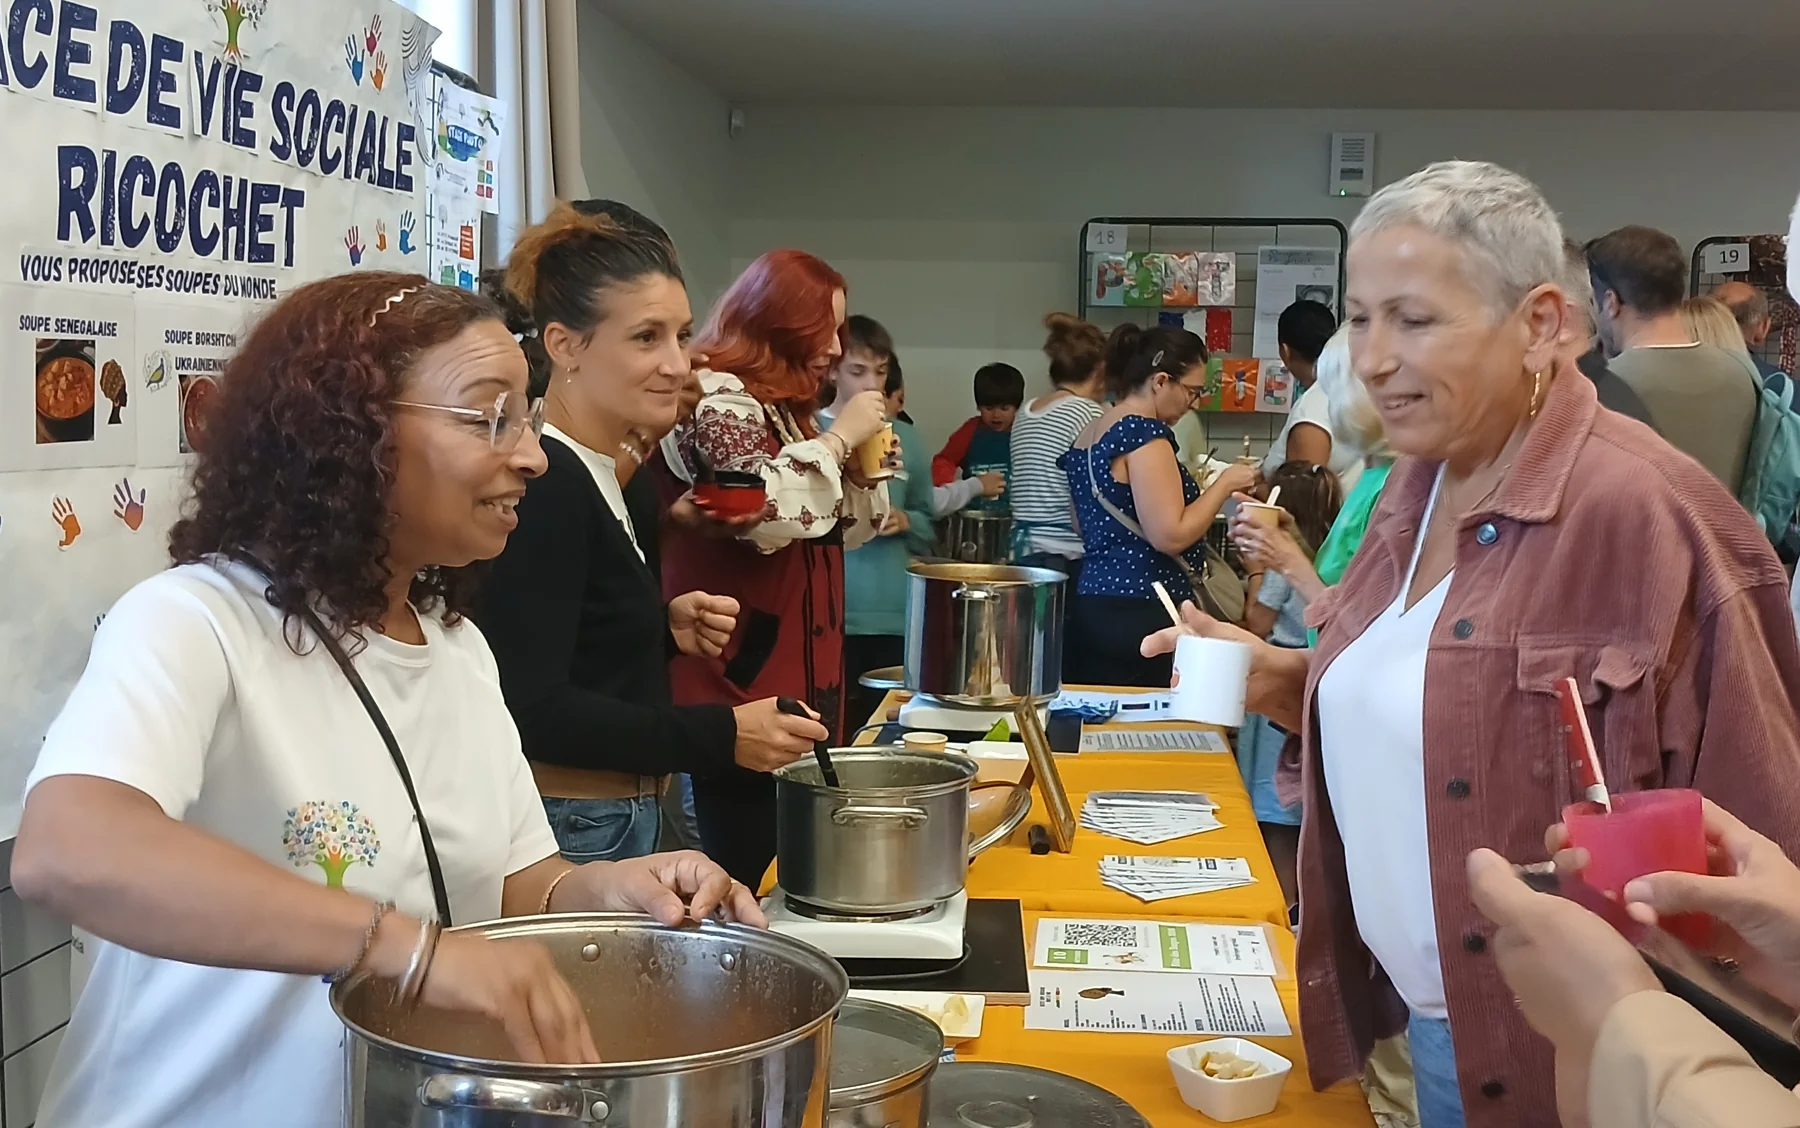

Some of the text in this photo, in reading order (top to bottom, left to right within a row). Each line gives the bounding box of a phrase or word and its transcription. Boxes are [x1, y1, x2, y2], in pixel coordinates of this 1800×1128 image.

[106, 20, 183, 128] DE
[194, 50, 263, 149] VIE
[269, 81, 415, 192] SOCIALE
[57, 145, 304, 267] RICOCHET
[1095, 230, 1115, 245] 18
[1719, 249, 1739, 264] 19
[21, 254, 278, 300] VOUS PROPOSE SES SOUPES DU MONDE
[19, 314, 117, 337] SOUPE SENEGALAISE
[164, 329, 193, 345] SOUPE
